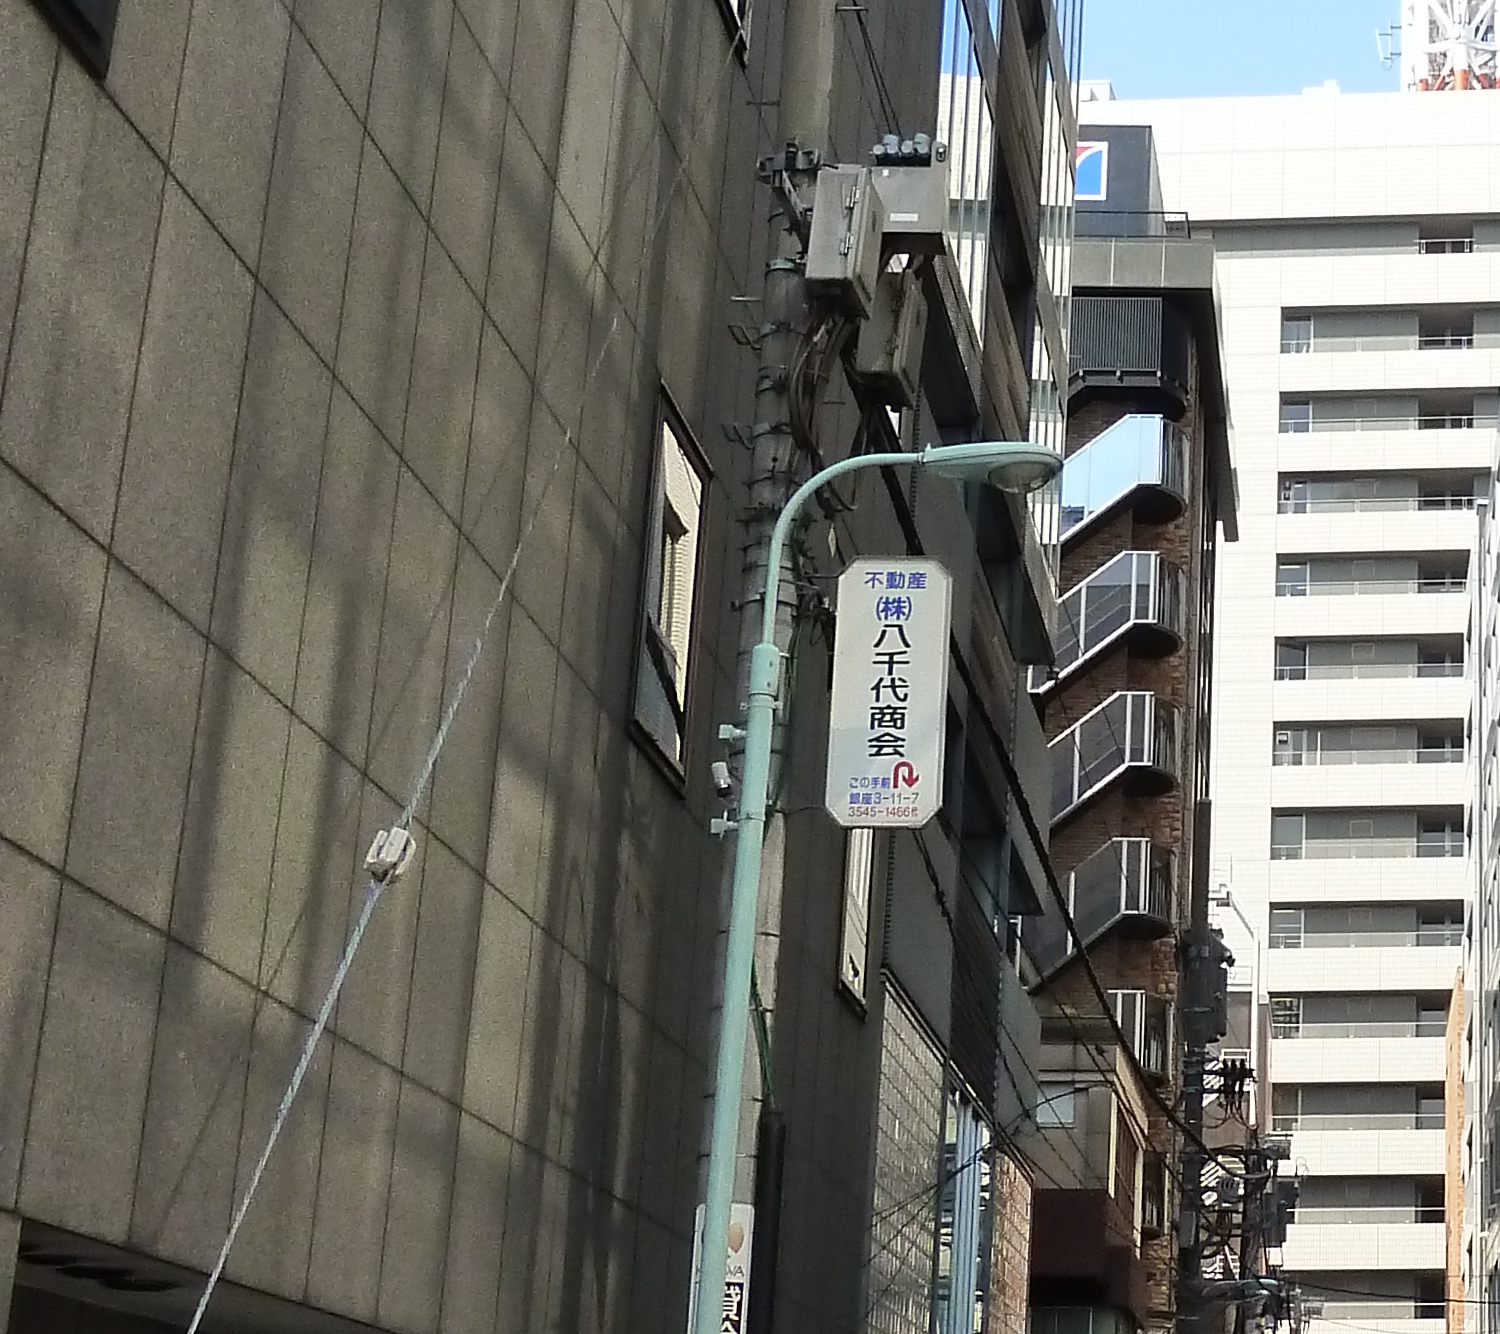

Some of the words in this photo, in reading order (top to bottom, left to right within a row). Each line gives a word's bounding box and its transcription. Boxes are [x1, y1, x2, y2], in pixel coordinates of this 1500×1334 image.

[864, 571, 927, 590] 不動産
[849, 777, 891, 789] この手前
